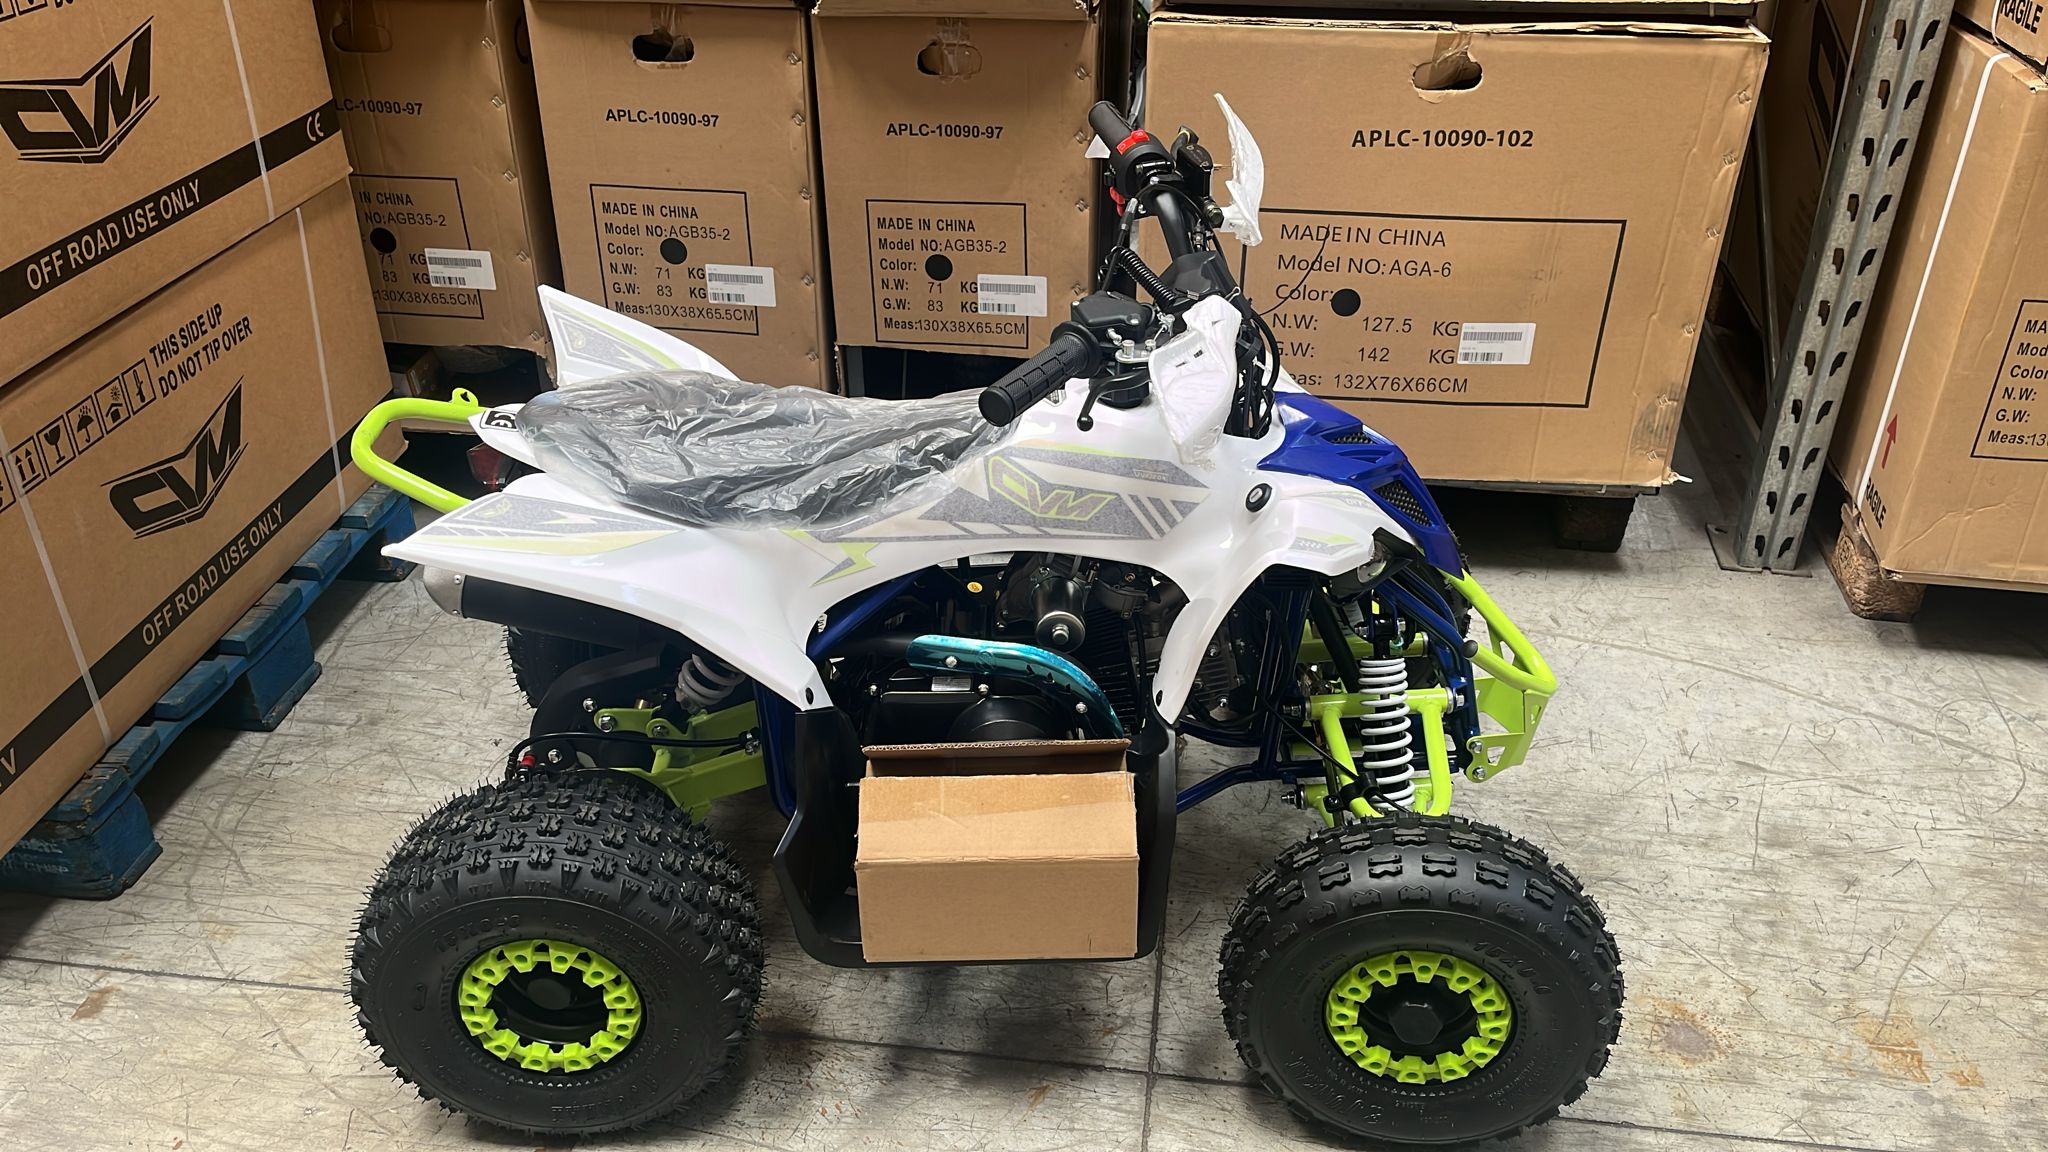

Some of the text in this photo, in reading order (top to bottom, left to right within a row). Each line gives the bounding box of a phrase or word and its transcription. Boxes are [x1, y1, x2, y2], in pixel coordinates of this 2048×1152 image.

[2000, 0, 2043, 34] RAGILE
[306, 111, 324, 142] CE
[606, 108, 719, 127] APLC-10090-97
[886, 123, 1004, 139] APLC-10090-97
[1352, 129, 1534, 148] APLC-10090-102
[376, 192, 414, 206] CHINA
[602, 202, 699, 219] MADE IN CHINA
[604, 222, 640, 237] Model
[877, 217, 976, 232] MADE IN CHINA
[26, 179, 200, 290] OFF ROAD USE ONLY
[1378, 228, 1446, 247] CHINA
[607, 242, 645, 257] Color:
[878, 238, 914, 251] Model
[379, 253, 427, 266] 71 KG
[880, 258, 917, 272] Color:
[1277, 254, 1341, 273] Model
[382, 270, 430, 285] 83 KG
[609, 262, 705, 280] N.W: 71 KG
[612, 282, 707, 300] G.W: 83 KG
[881, 278, 978, 294] N.W: 71 KG
[883, 298, 978, 314] G.W: 83 KG
[1272, 313, 1459, 337] N.W: 127.5 KG
[149, 303, 223, 368] THIS SIDE UP
[158, 316, 253, 398] DO NOT TIP OVER
[1357, 347, 1390, 363] 142
[1429, 349, 1456, 365] KG
[1333, 374, 1468, 393] 132X76X66CM
[2002, 387, 2037, 402] N.W:
[1995, 408, 2030, 424] G.W:
[1987, 430, 2048, 447] Meas:13
[105, 379, 245, 535] CVM
[1866, 476, 1886, 529] RAGILE
[142, 503, 284, 645] OFF ROAD USE ONLY
